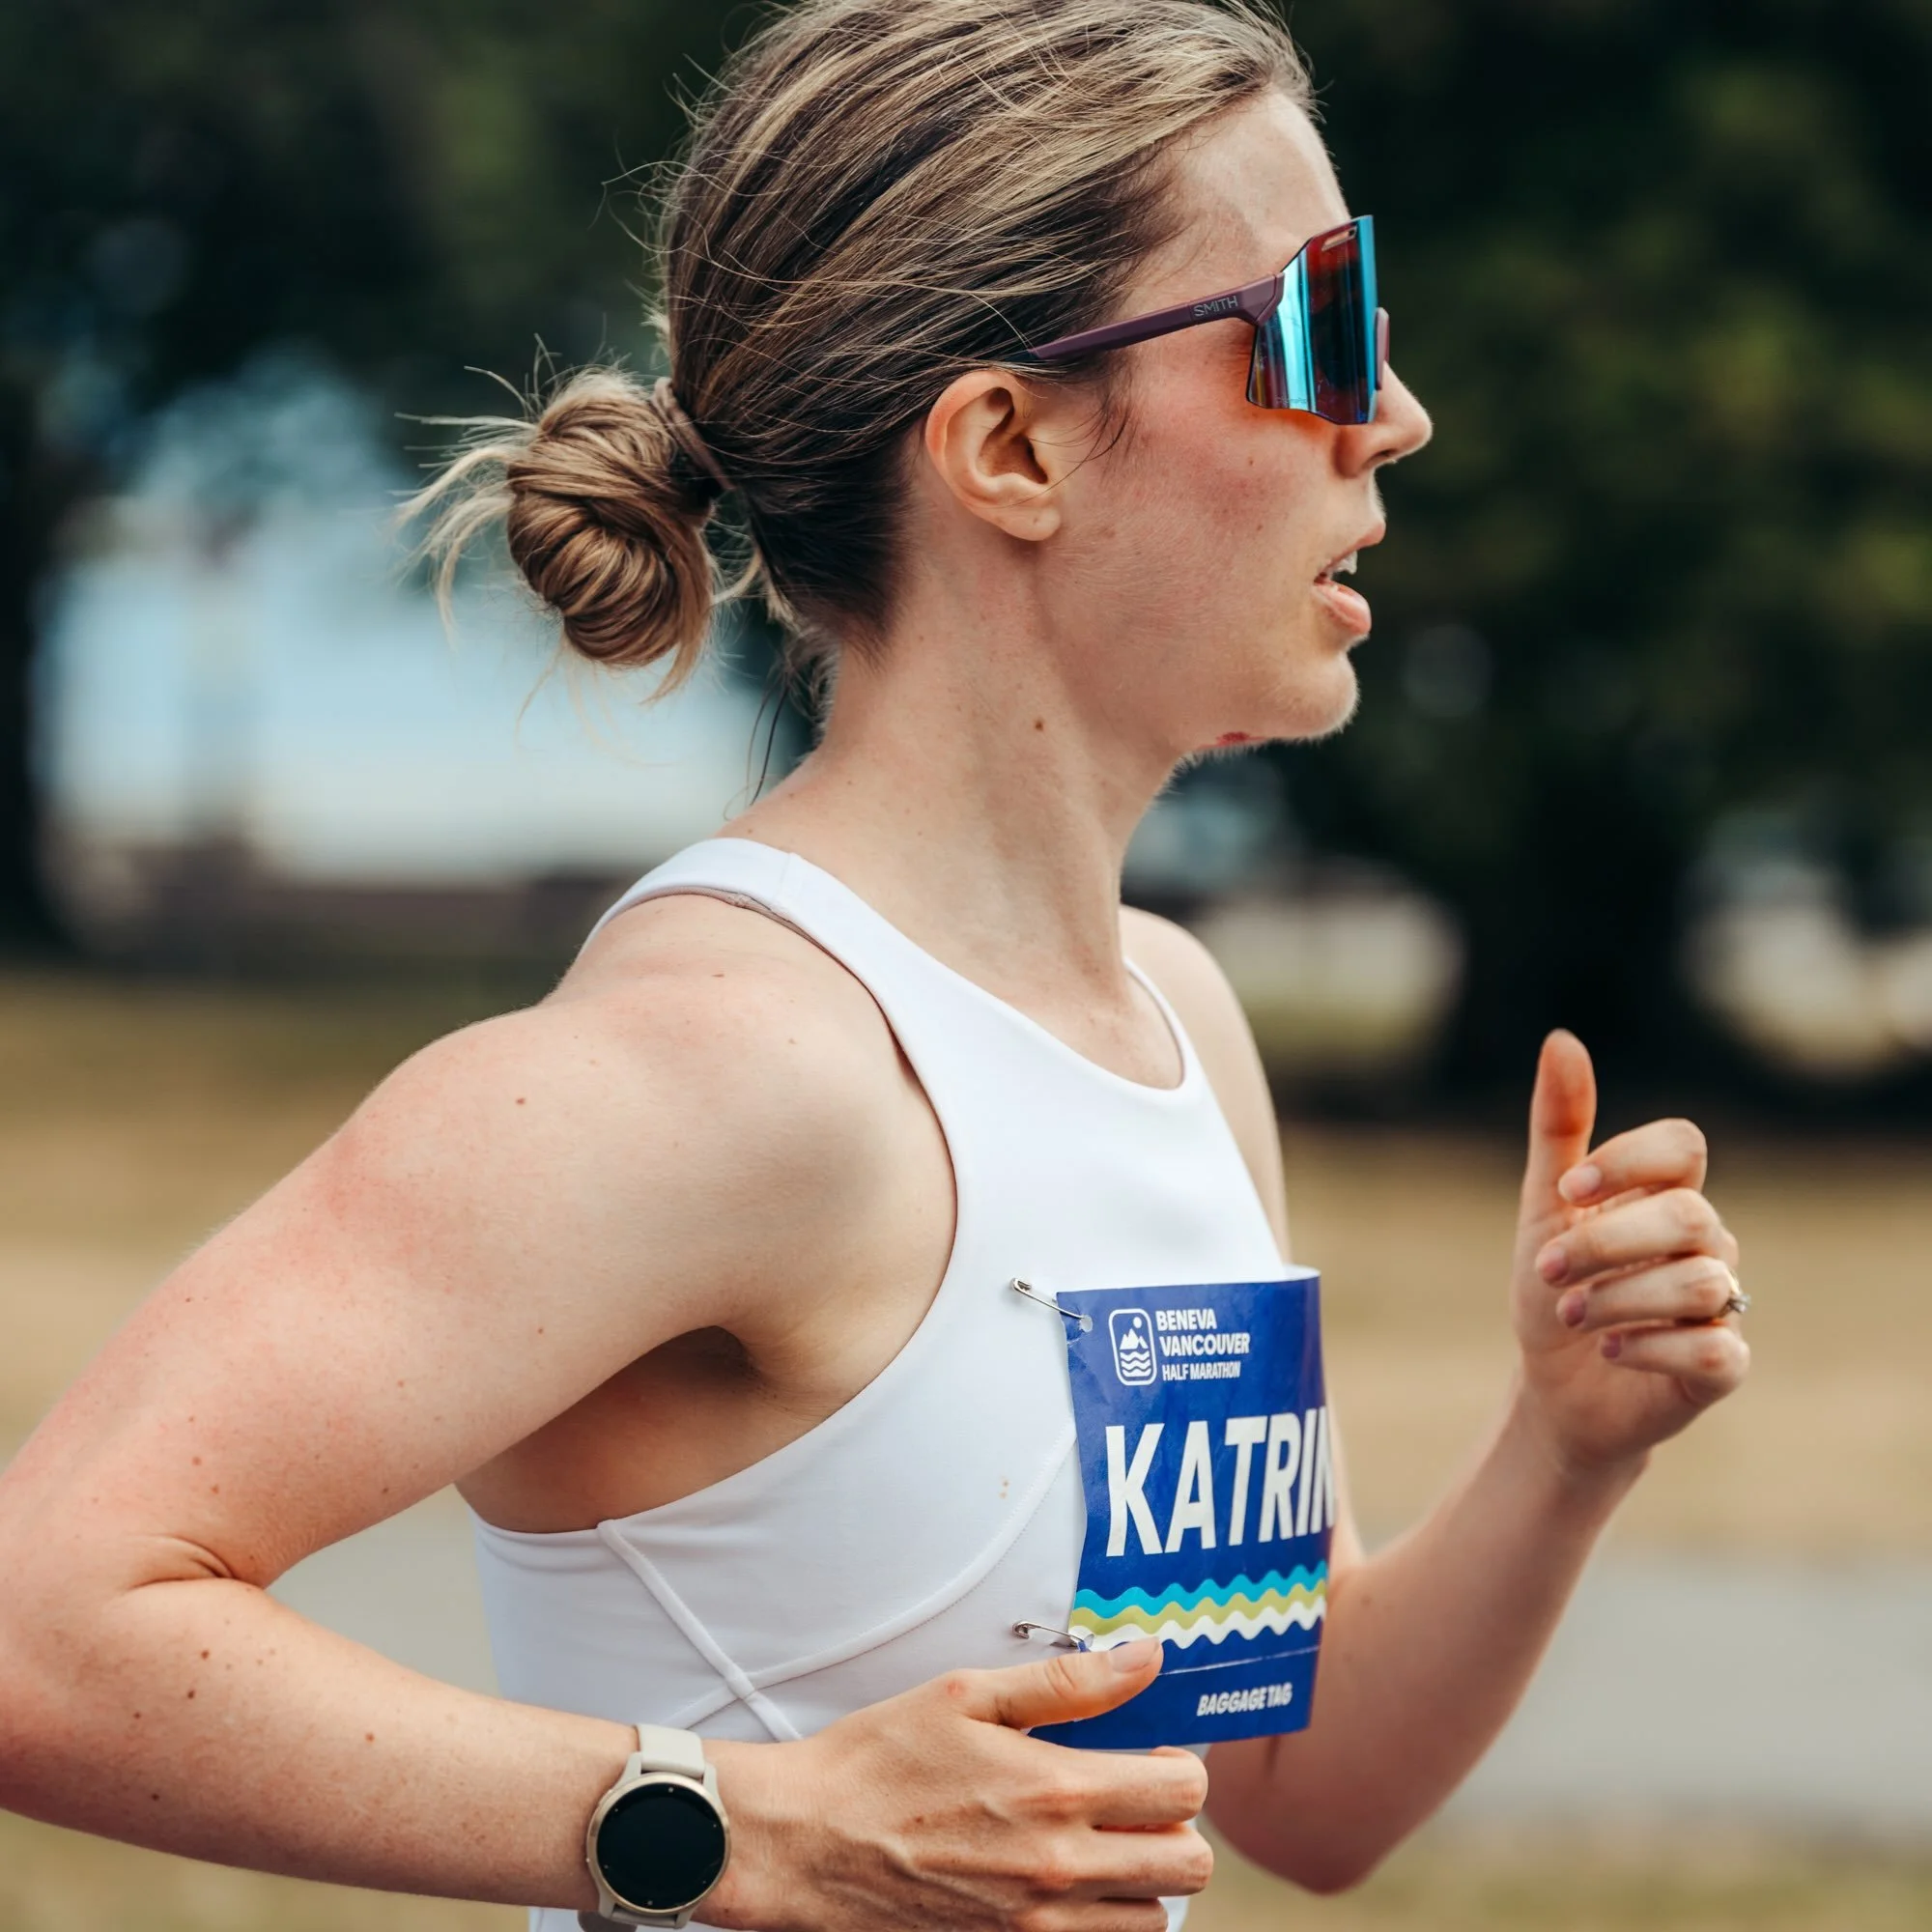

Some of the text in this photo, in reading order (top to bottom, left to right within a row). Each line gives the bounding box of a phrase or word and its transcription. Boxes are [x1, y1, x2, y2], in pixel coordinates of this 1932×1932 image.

[1193, 295, 1238, 317] SMITH
[1155, 1308, 1217, 1331] BENEVA
[1159, 1332, 1251, 1356] VANCOUVER
[1162, 1360, 1241, 1381] HALF MARATHON
[1196, 1682, 1293, 1717] BAGGAGE TAG
